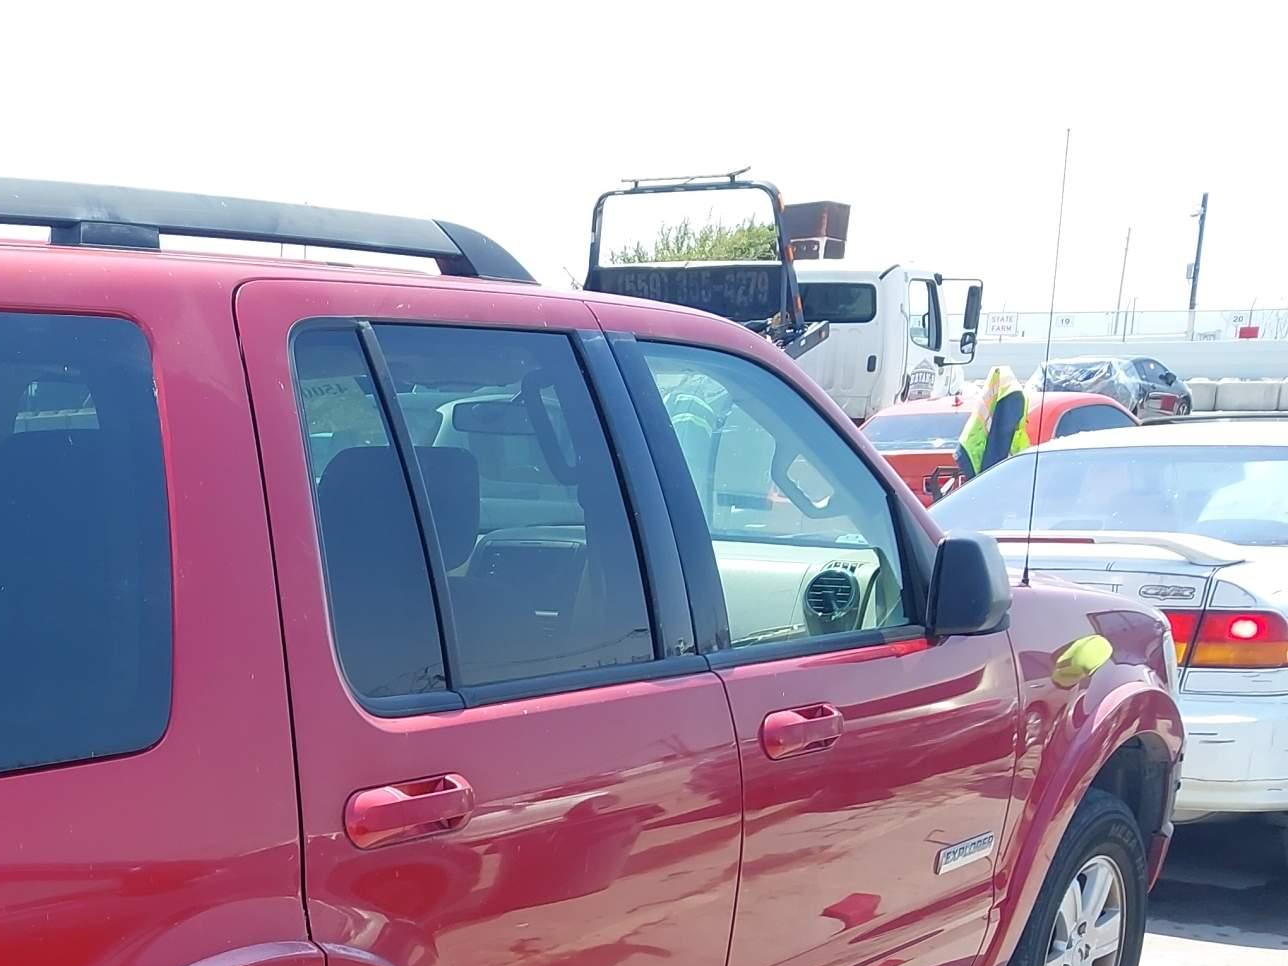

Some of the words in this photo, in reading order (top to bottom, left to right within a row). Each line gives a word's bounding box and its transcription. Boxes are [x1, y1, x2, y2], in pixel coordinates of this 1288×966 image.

[991, 315, 1013, 323] STATE
[1232, 315, 1243, 323] 20
[944, 835, 994, 865] EXPLORER
